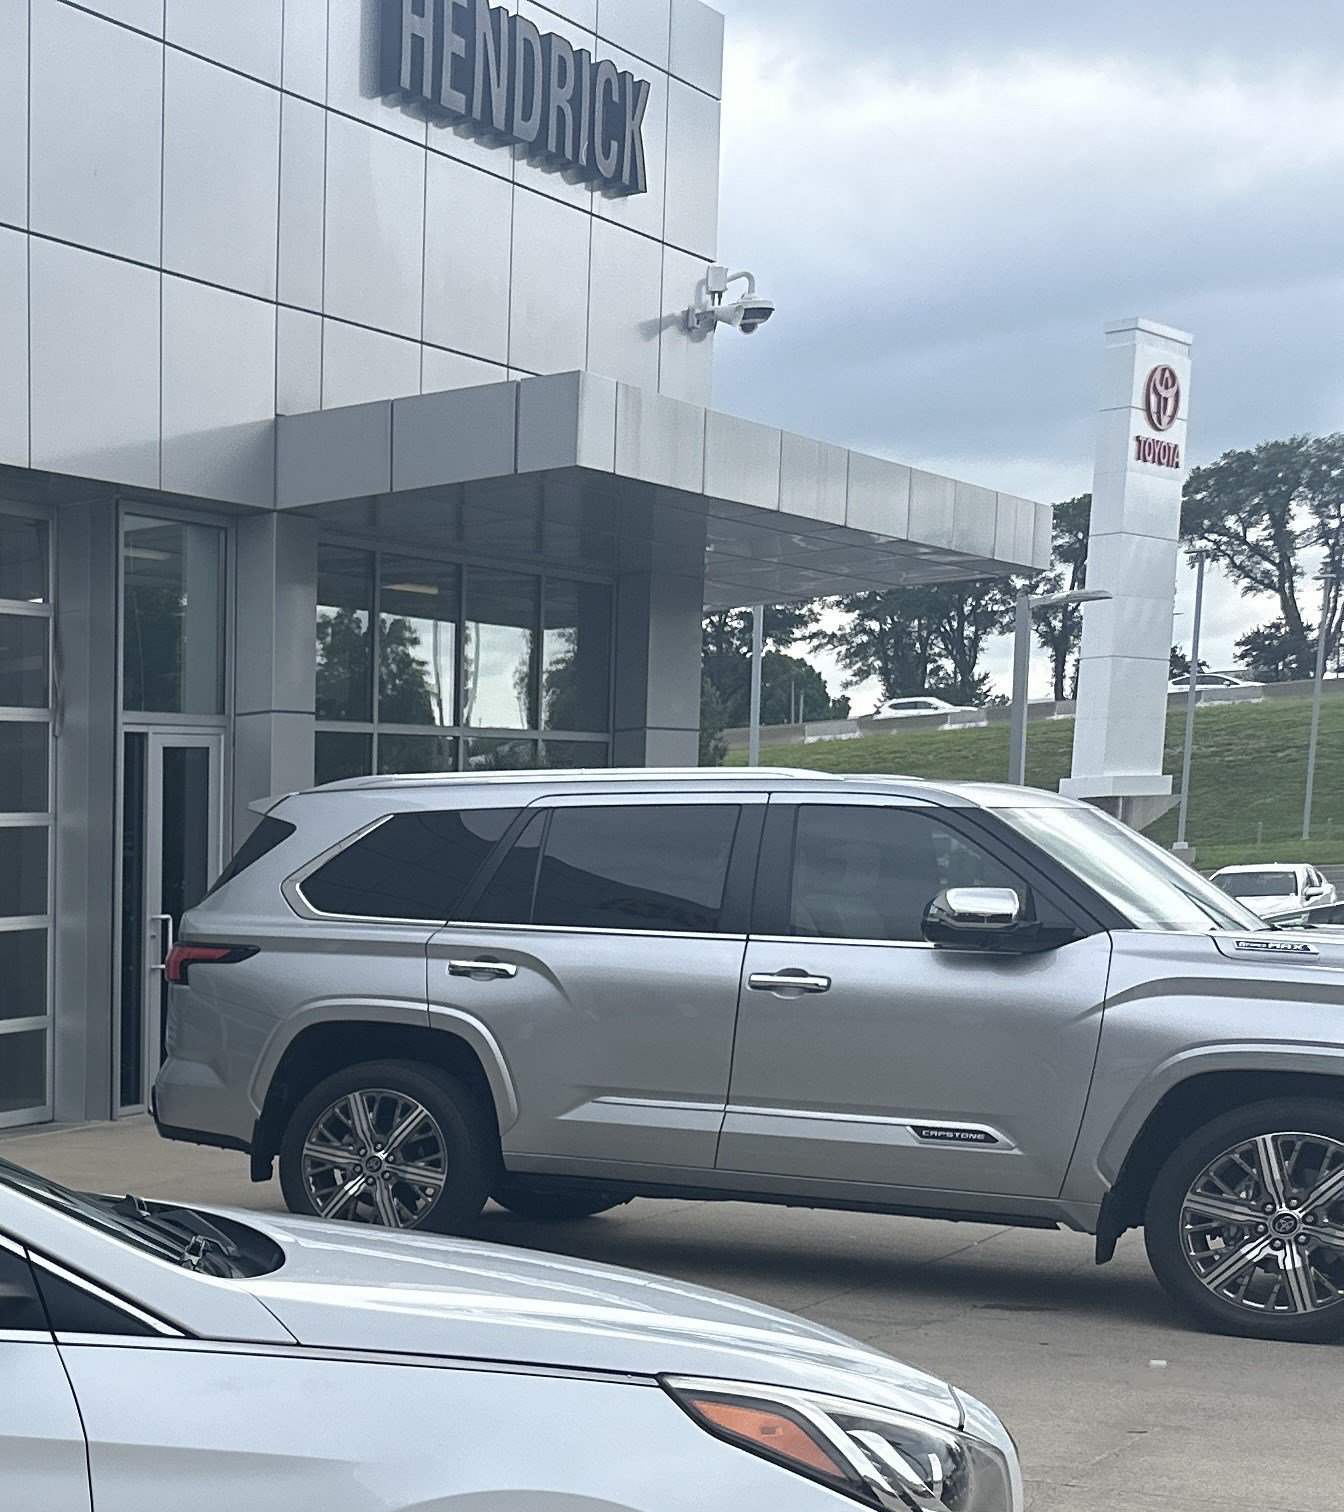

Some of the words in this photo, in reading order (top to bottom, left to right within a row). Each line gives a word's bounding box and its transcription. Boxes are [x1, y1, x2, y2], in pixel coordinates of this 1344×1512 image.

[380, 0, 650, 195] HENDRICK
[1134, 435, 1180, 469] TOYOTA
[922, 1130, 986, 1140] CAPSTONE
